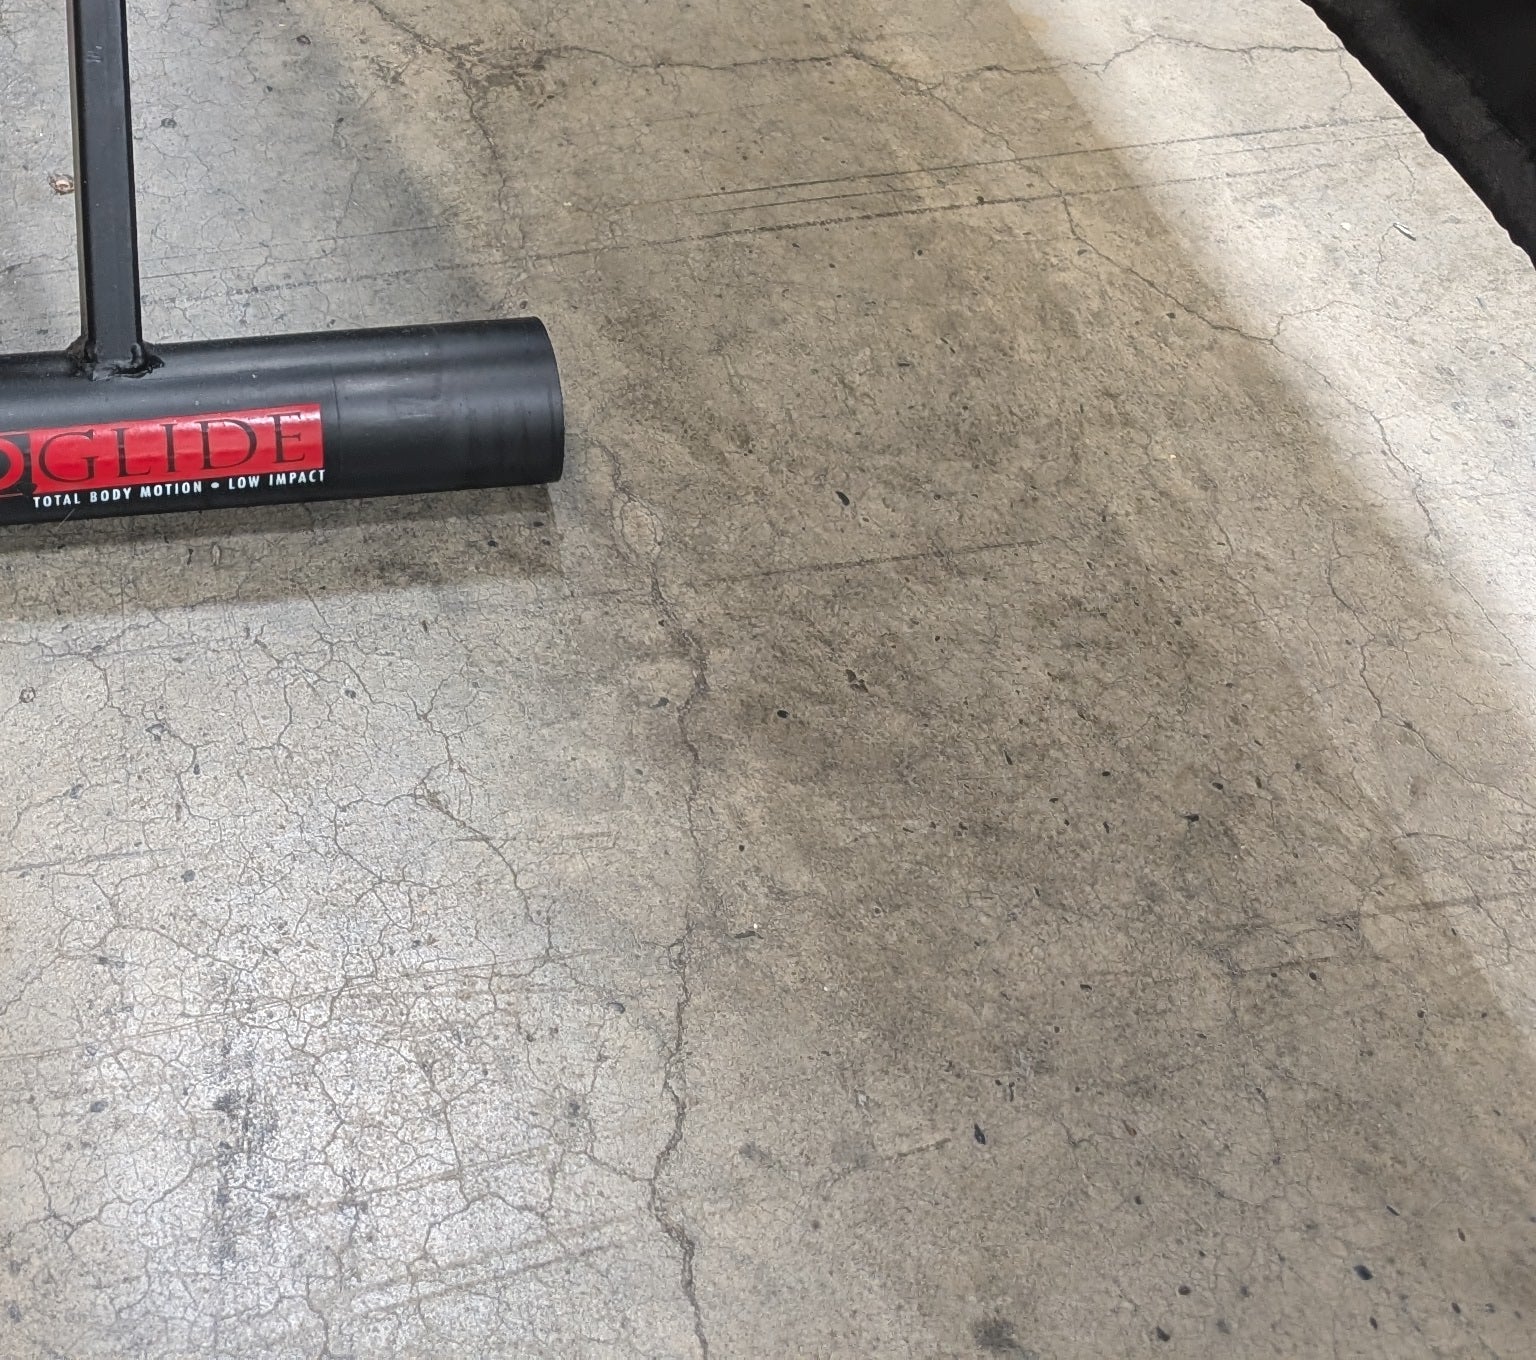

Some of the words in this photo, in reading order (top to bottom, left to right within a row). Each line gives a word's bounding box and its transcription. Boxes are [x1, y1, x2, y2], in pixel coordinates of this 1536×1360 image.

[33, 493, 81, 509] TOTAL
[89, 486, 132, 503] BODY
[139, 481, 203, 498] MOTION
[228, 475, 261, 490] LOW
[268, 469, 326, 486] IMPACT
